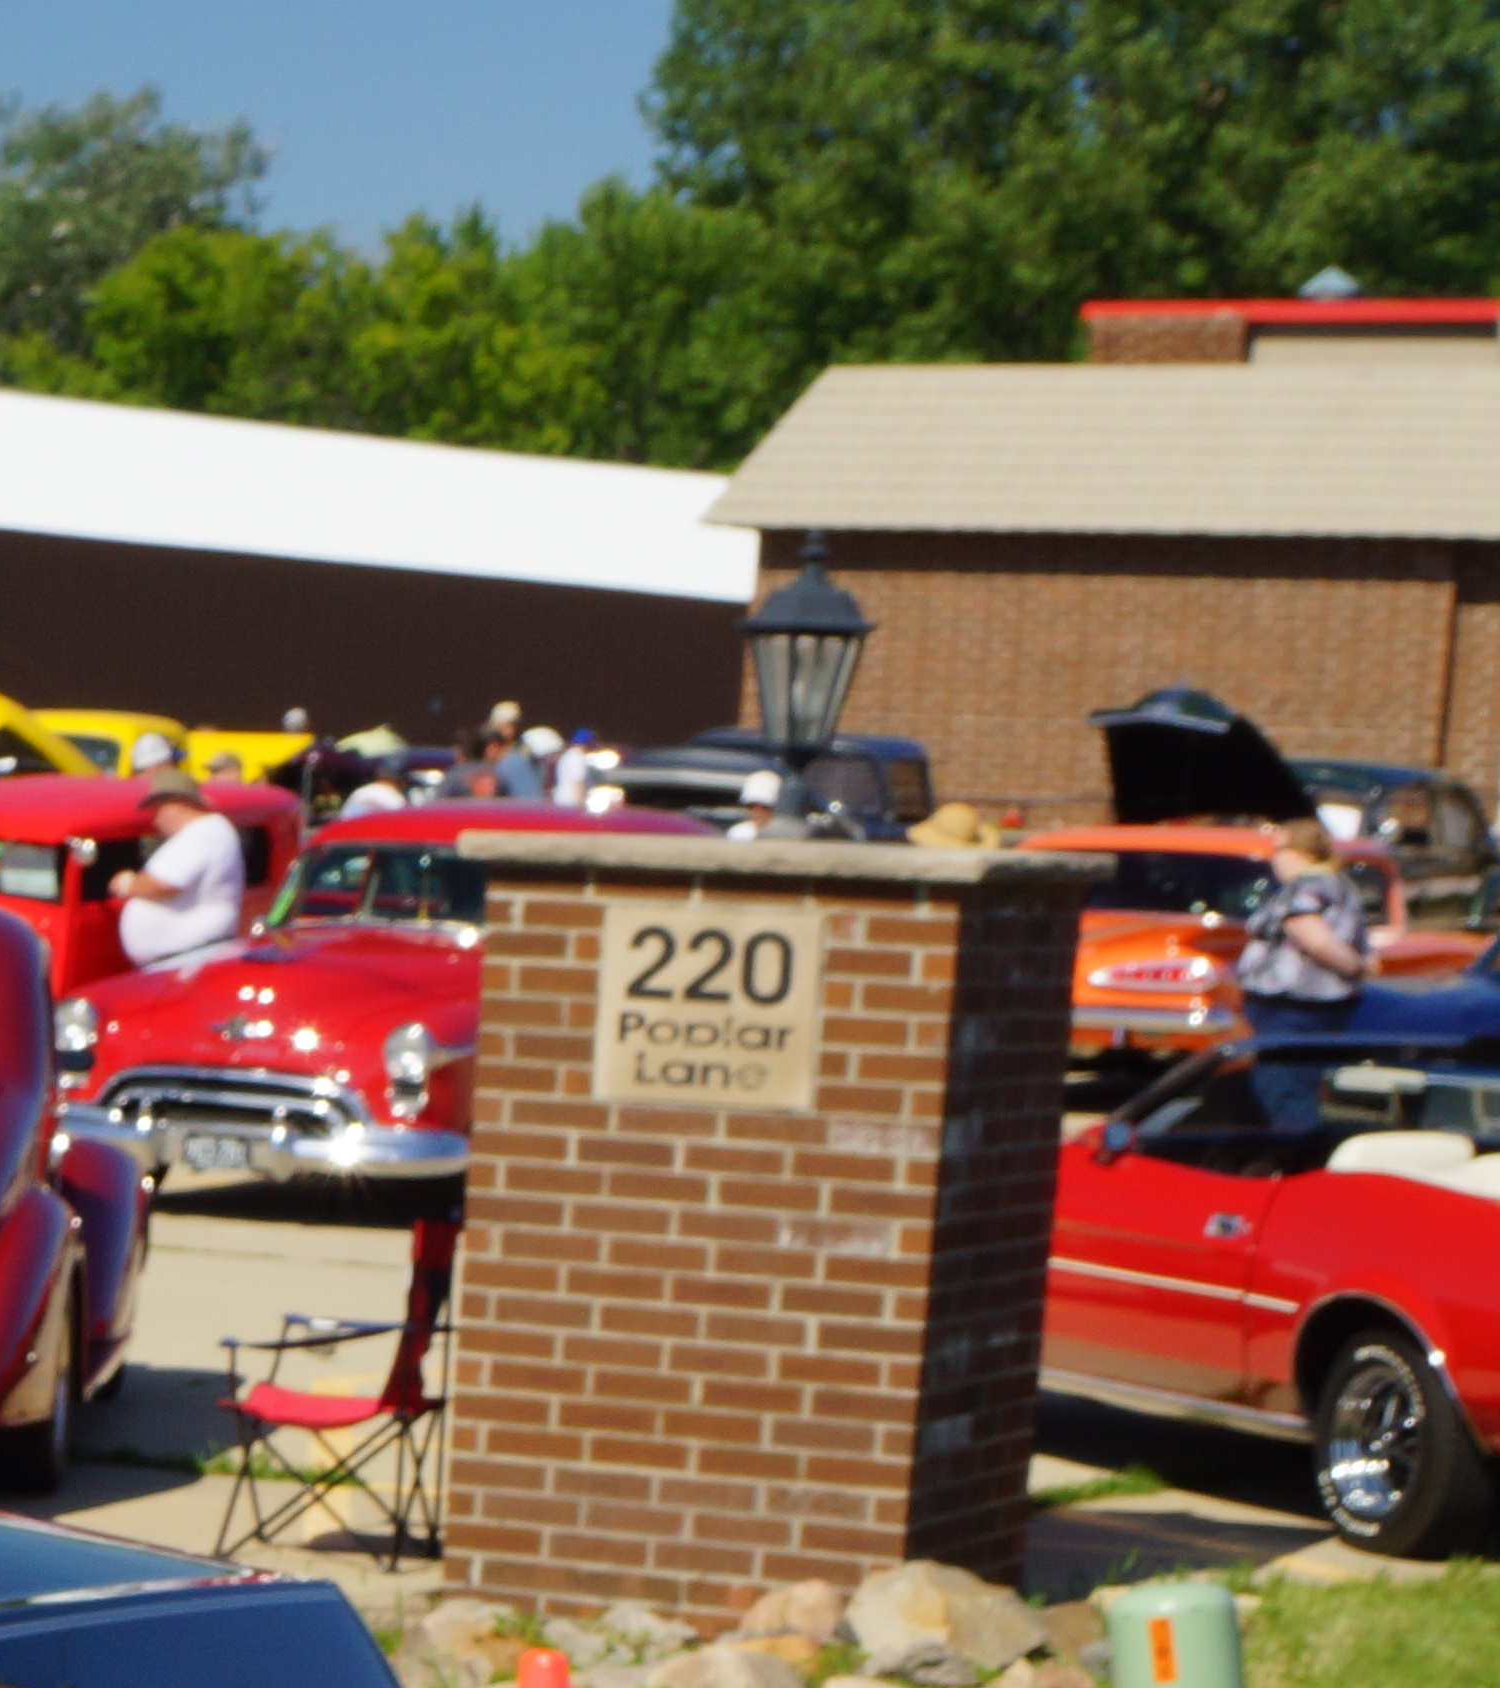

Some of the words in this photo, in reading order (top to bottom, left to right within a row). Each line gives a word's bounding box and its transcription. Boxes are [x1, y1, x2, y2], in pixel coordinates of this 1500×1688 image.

[626, 925, 793, 1007] 220
[617, 1011, 792, 1050] Poplar
[635, 1052, 768, 1092] Lane
